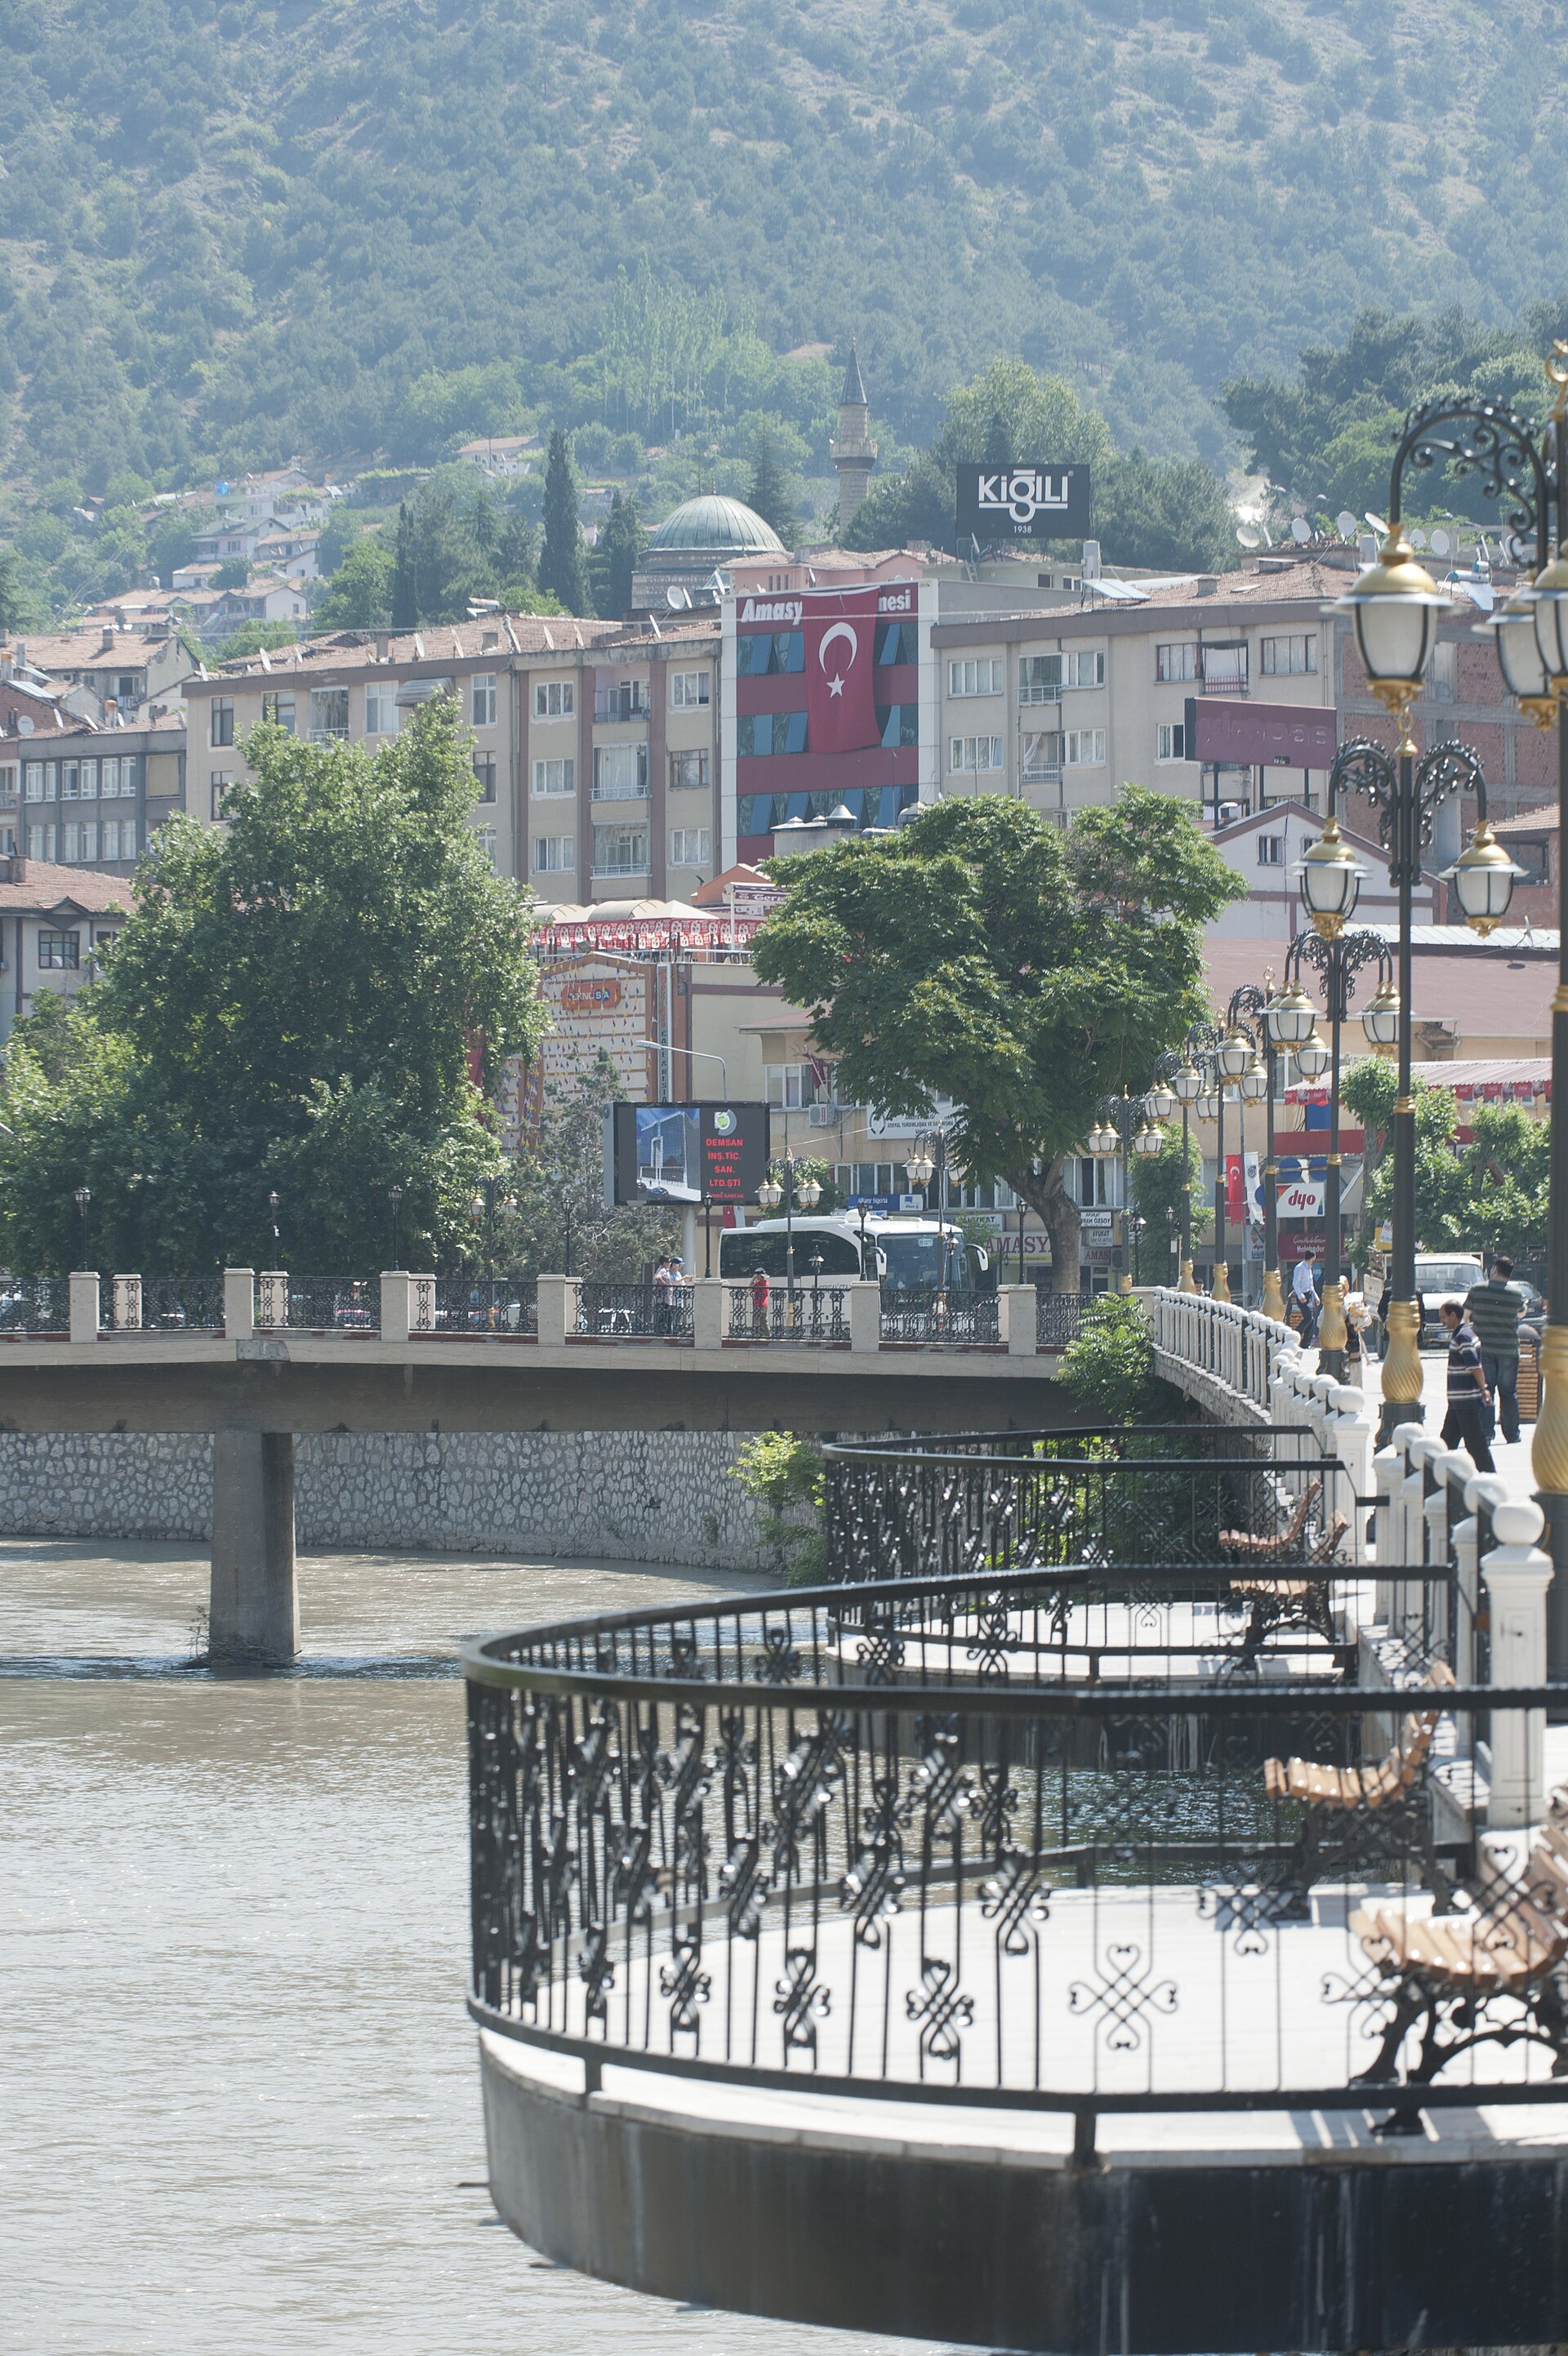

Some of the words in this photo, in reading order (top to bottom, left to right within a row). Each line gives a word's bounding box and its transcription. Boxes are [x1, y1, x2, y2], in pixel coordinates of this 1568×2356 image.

[1013, 525, 1032, 534] 1938
[706, 1138, 744, 1147] DEMSAN
[715, 1165, 735, 1174] SAN.
[709, 1178, 741, 1188] LTD.ŞTİ
[1288, 1190, 1316, 1210] dyo
[986, 1236, 1052, 1254] AMASY
[1085, 1250, 1111, 1260] AMAS
